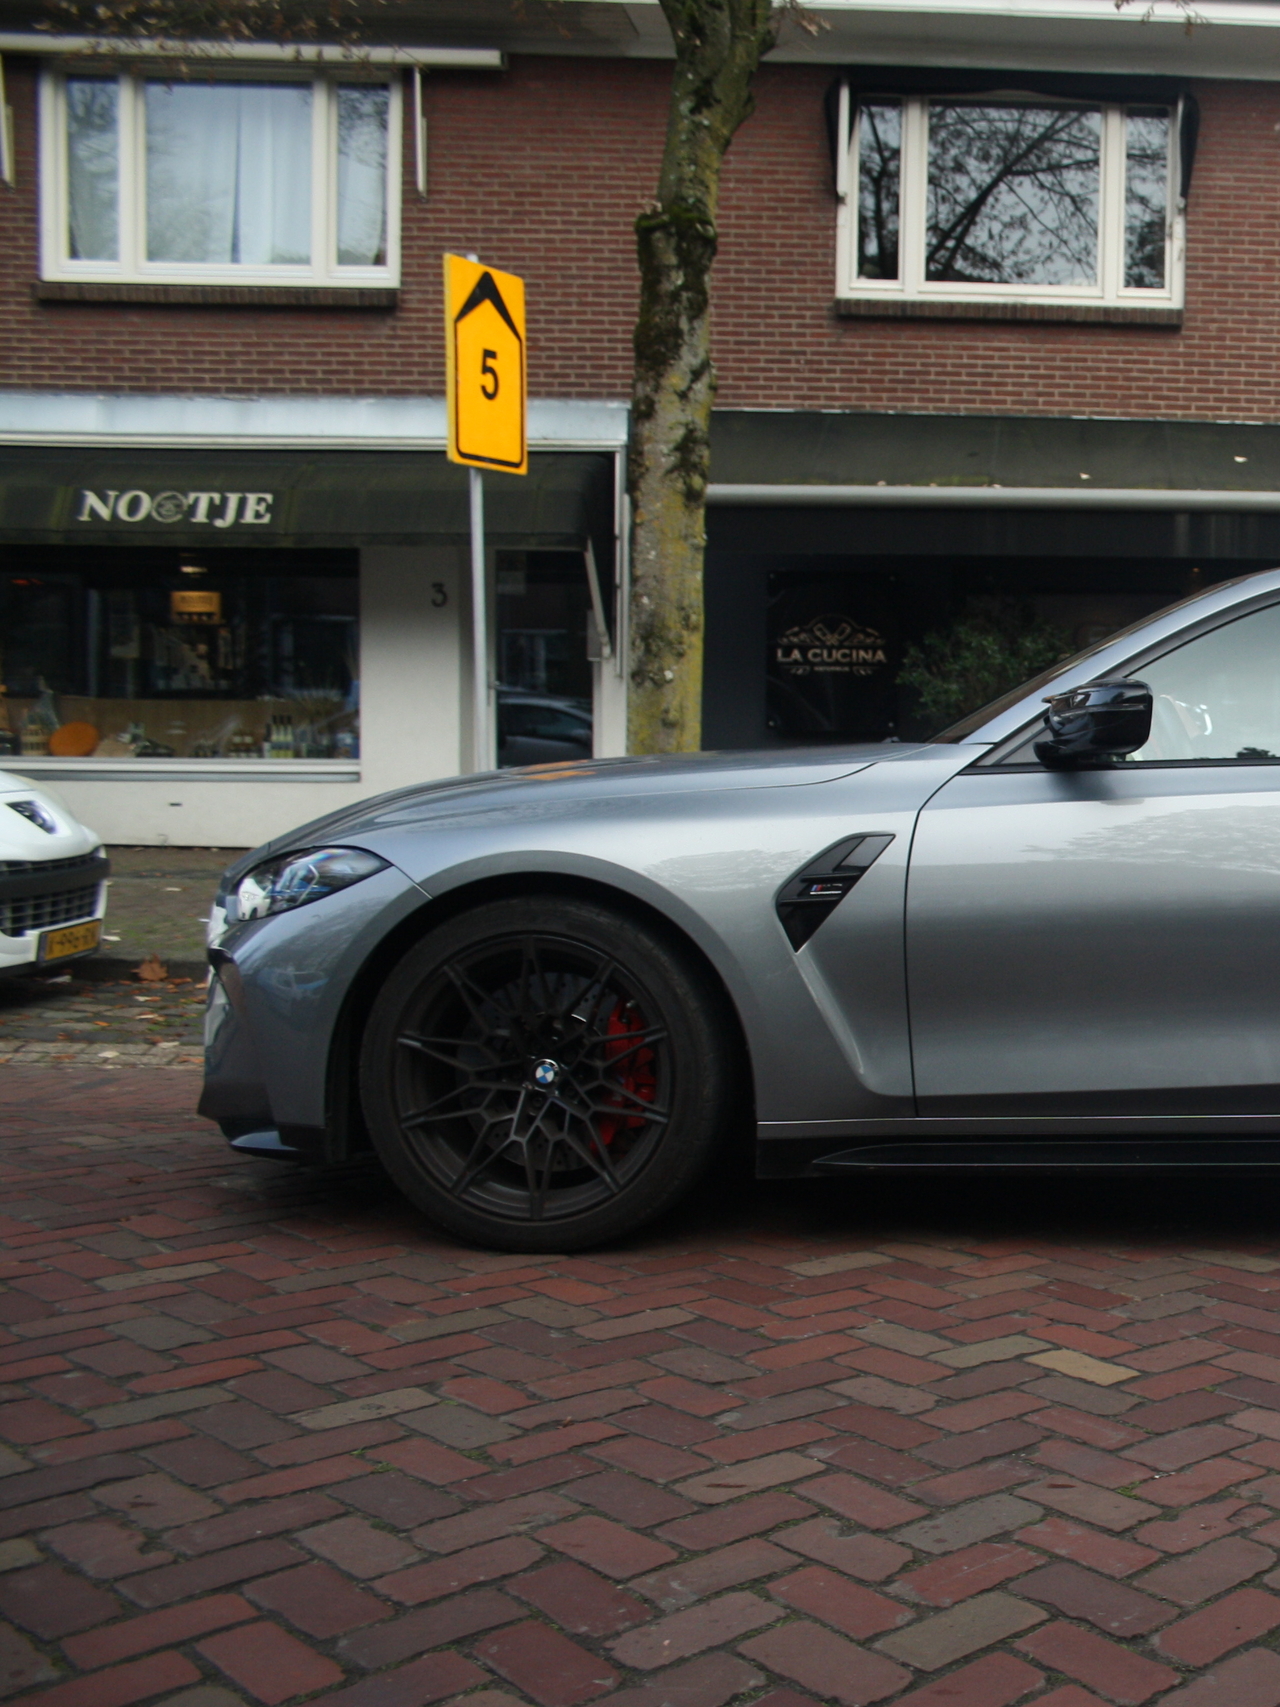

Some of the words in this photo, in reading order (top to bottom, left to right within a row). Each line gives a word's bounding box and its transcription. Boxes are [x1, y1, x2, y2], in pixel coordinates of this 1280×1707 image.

[481, 348, 499, 401] 5
[431, 582, 448, 608] 3
[776, 648, 803, 662] LA
[807, 648, 887, 663] CUCINA
